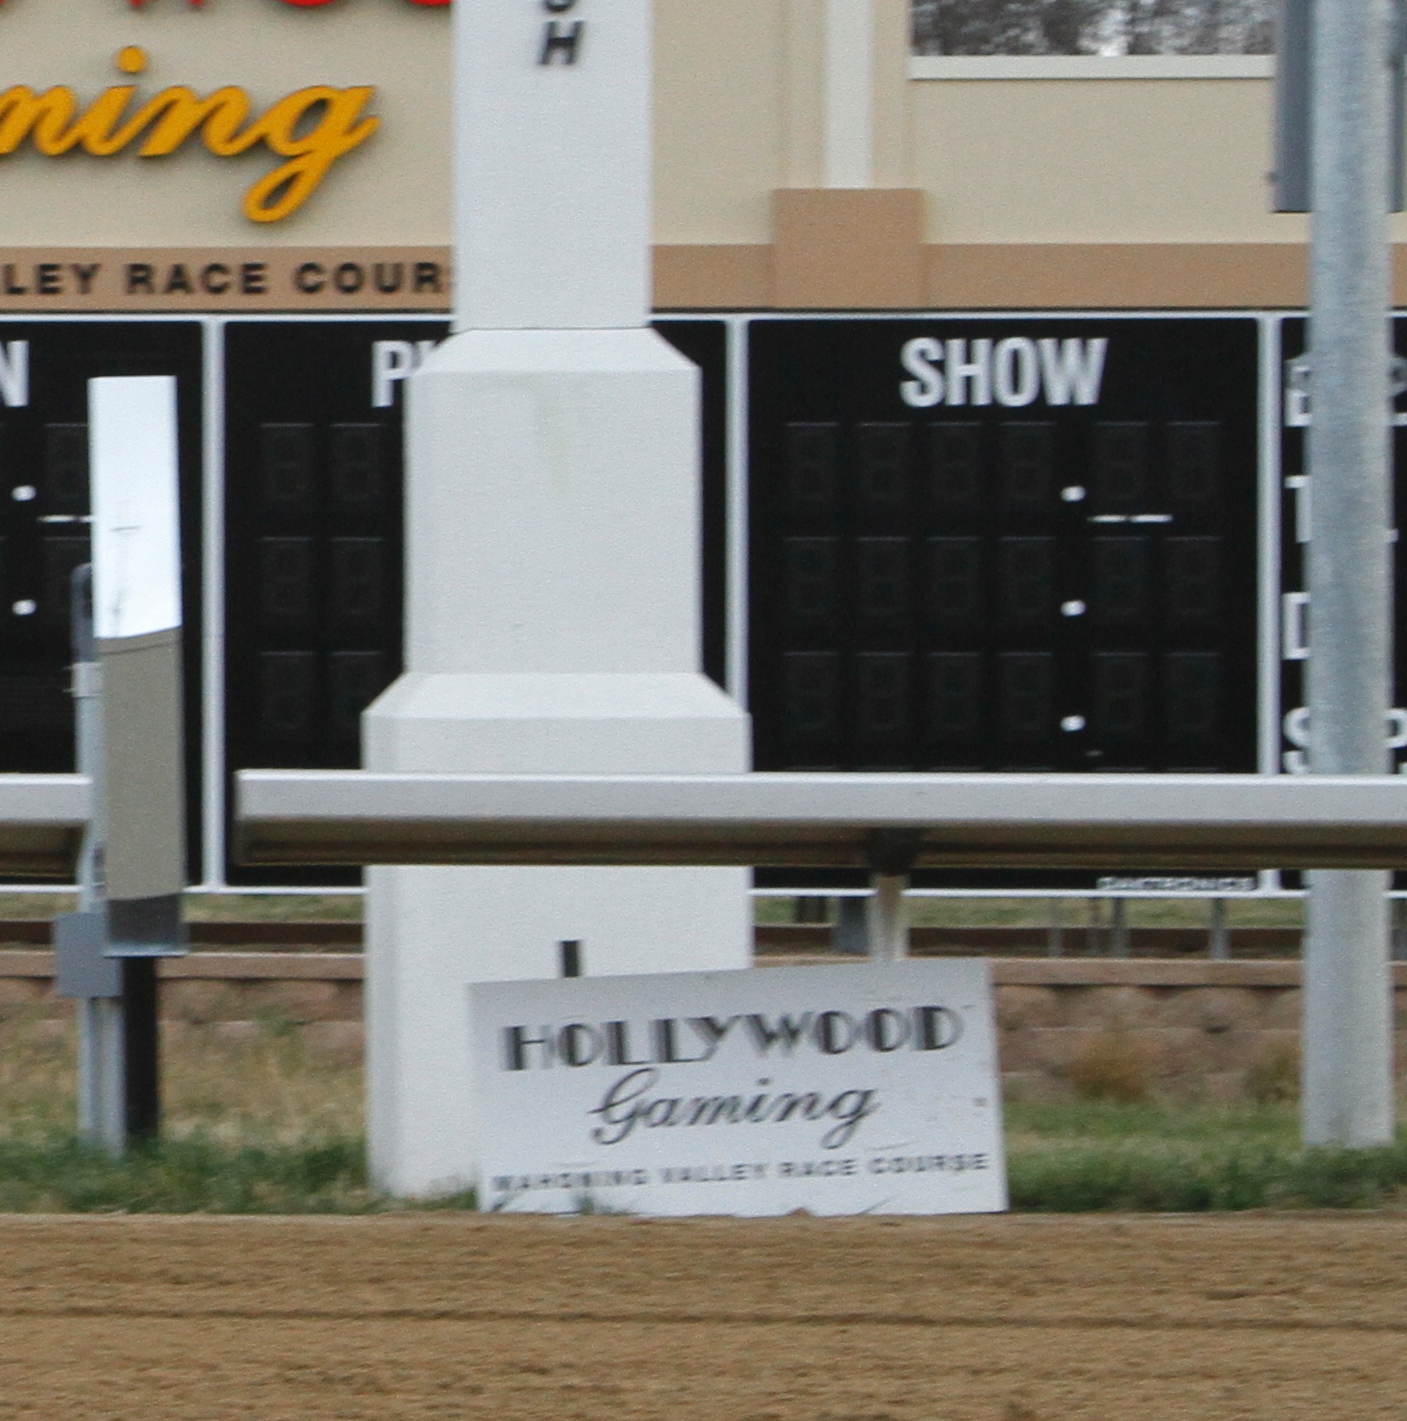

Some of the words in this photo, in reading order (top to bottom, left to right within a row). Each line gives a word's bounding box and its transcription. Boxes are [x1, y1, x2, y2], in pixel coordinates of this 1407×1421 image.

[126, 263, 268, 295] RACE
[900, 337, 1108, 408] SHOW
[502, 1005, 966, 1071] HOLLYWOOD
[586, 1066, 882, 1150] Gaming
[660, 1162, 767, 1185] VALLEY
[782, 1158, 858, 1179] RACE
[868, 1152, 989, 1175] COURSE
